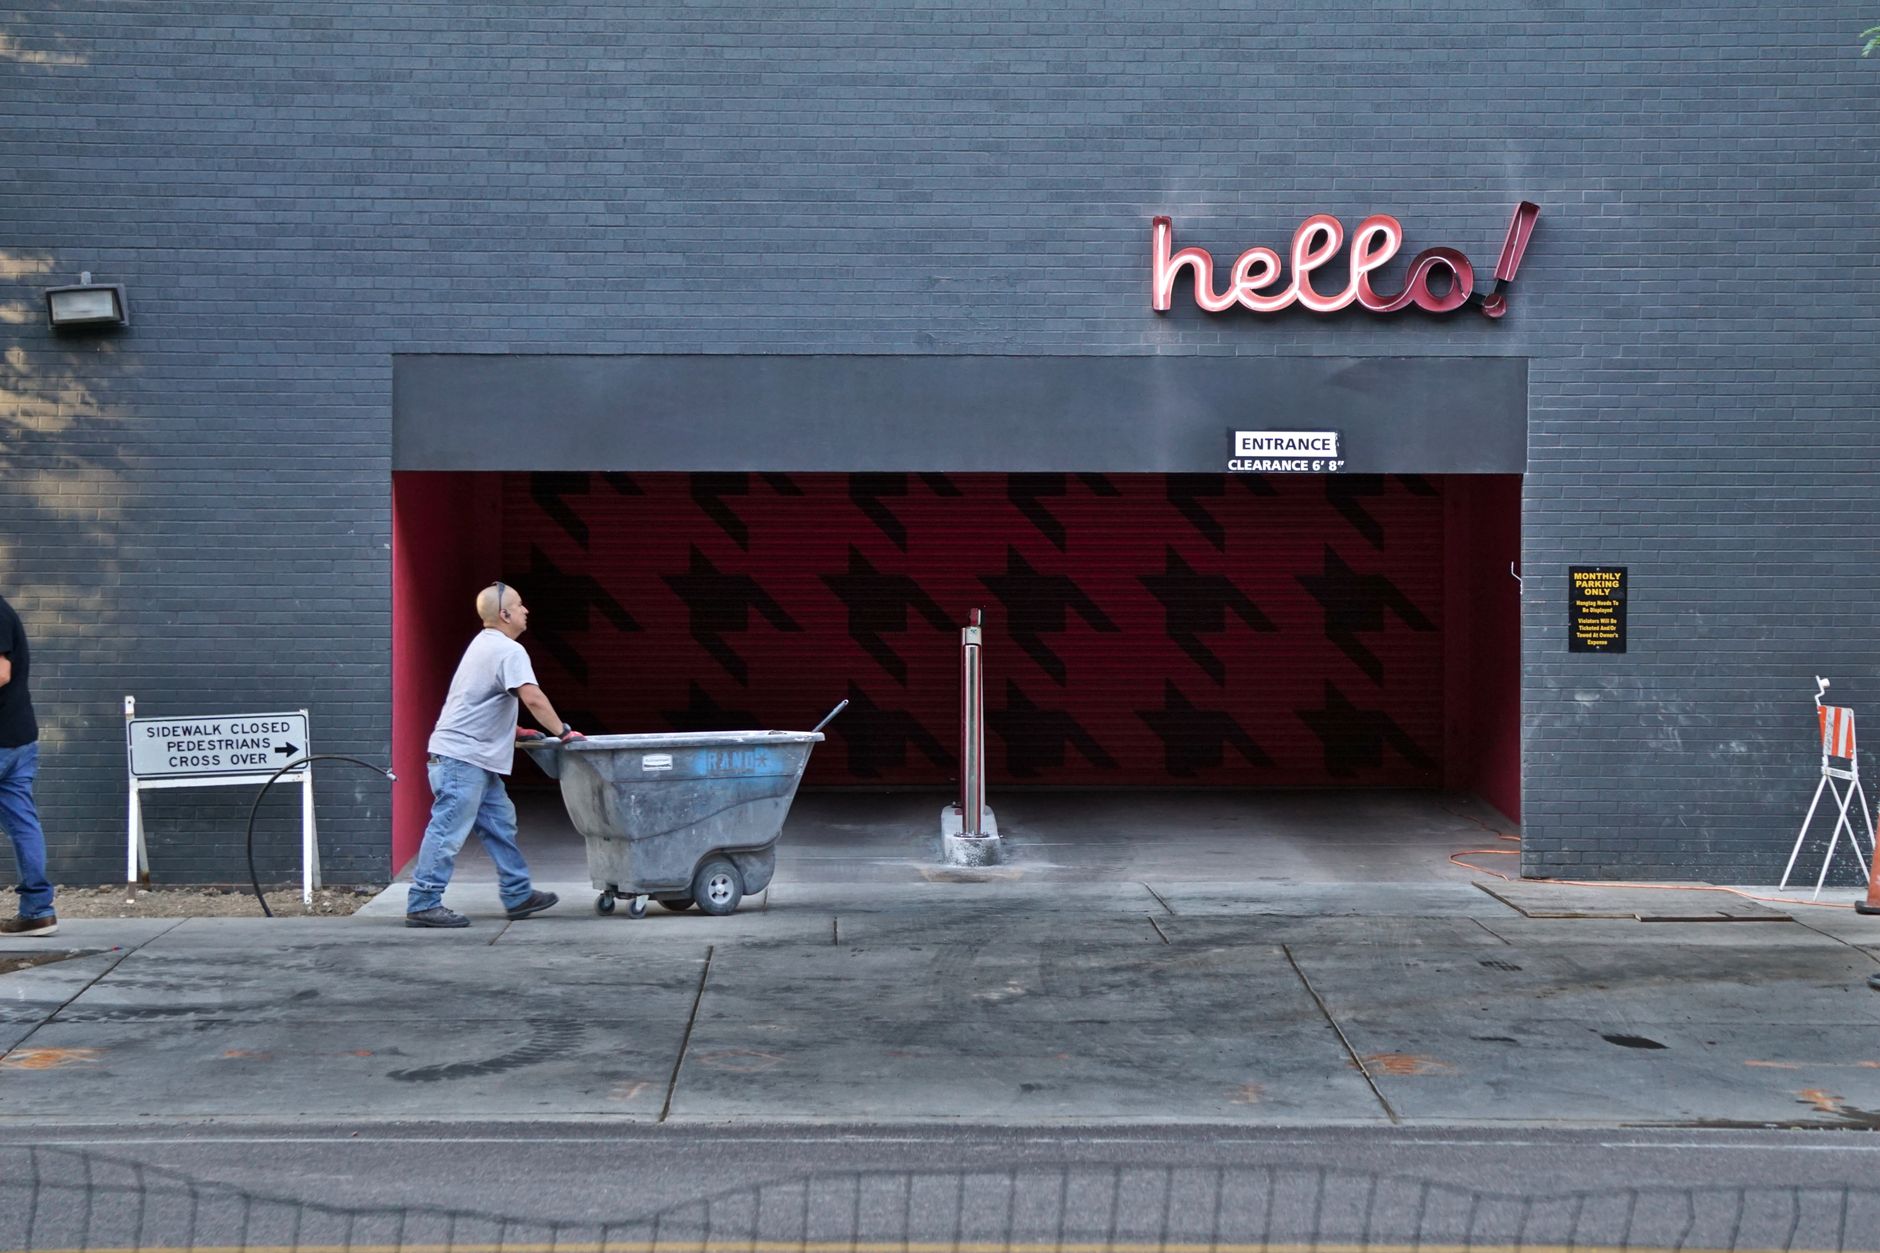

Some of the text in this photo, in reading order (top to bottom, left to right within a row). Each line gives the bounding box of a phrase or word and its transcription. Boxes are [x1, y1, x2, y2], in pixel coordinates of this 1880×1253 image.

[1152, 200, 1541, 319] hello!
[1242, 438, 1331, 450] ENTRANCE
[1228, 460, 1309, 471] CLEARANCE
[1574, 572, 1621, 580] MONTHLY
[1576, 580, 1619, 588] PARKING
[1584, 588, 1611, 596] ONLY
[146, 721, 290, 738] SIDEWALK CLOSED
[166, 737, 271, 752] PEDESTRIANS
[168, 753, 268, 768] CROSS OVER
